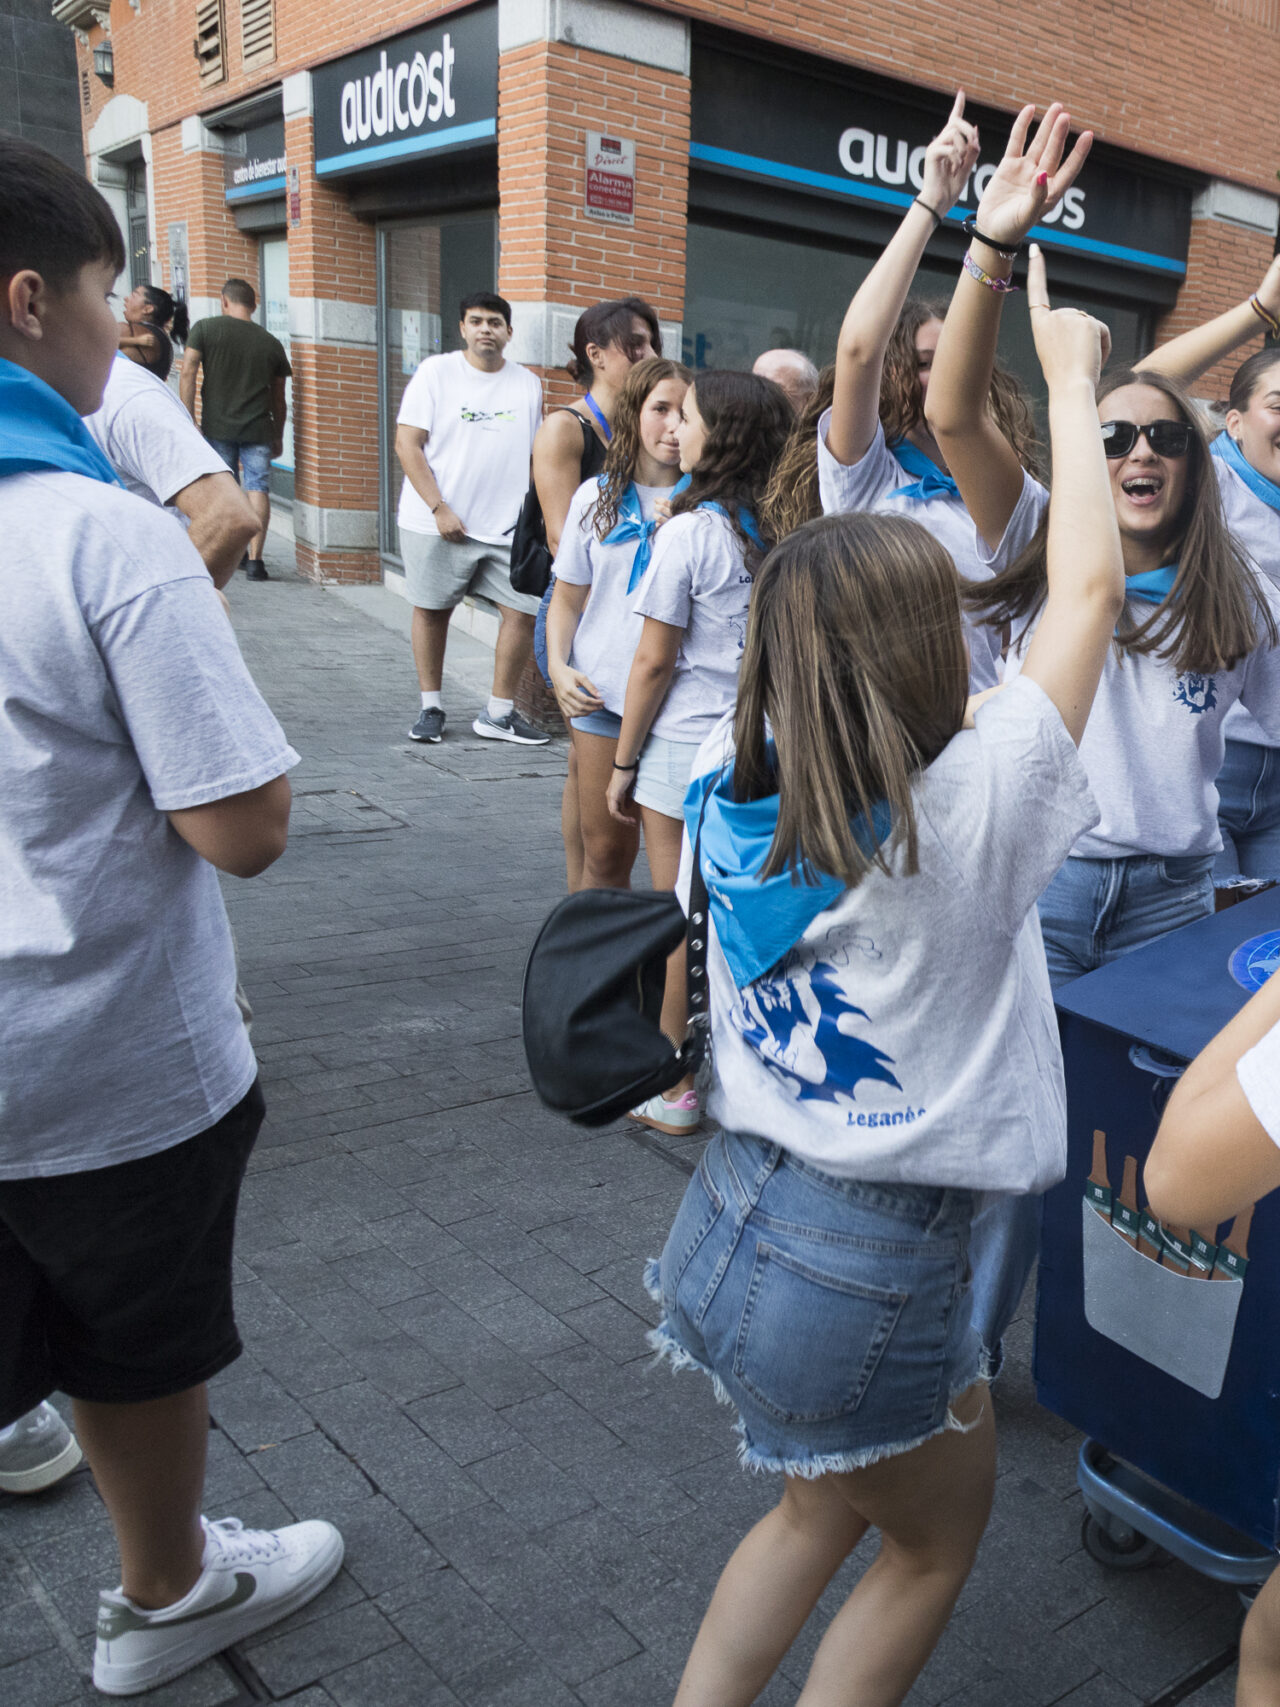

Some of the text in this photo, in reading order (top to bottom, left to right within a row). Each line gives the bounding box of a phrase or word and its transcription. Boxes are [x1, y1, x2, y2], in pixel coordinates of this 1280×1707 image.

[341, 33, 456, 145] audicost
[590, 172, 633, 190] Alarma
[588, 183, 633, 199] conectada
